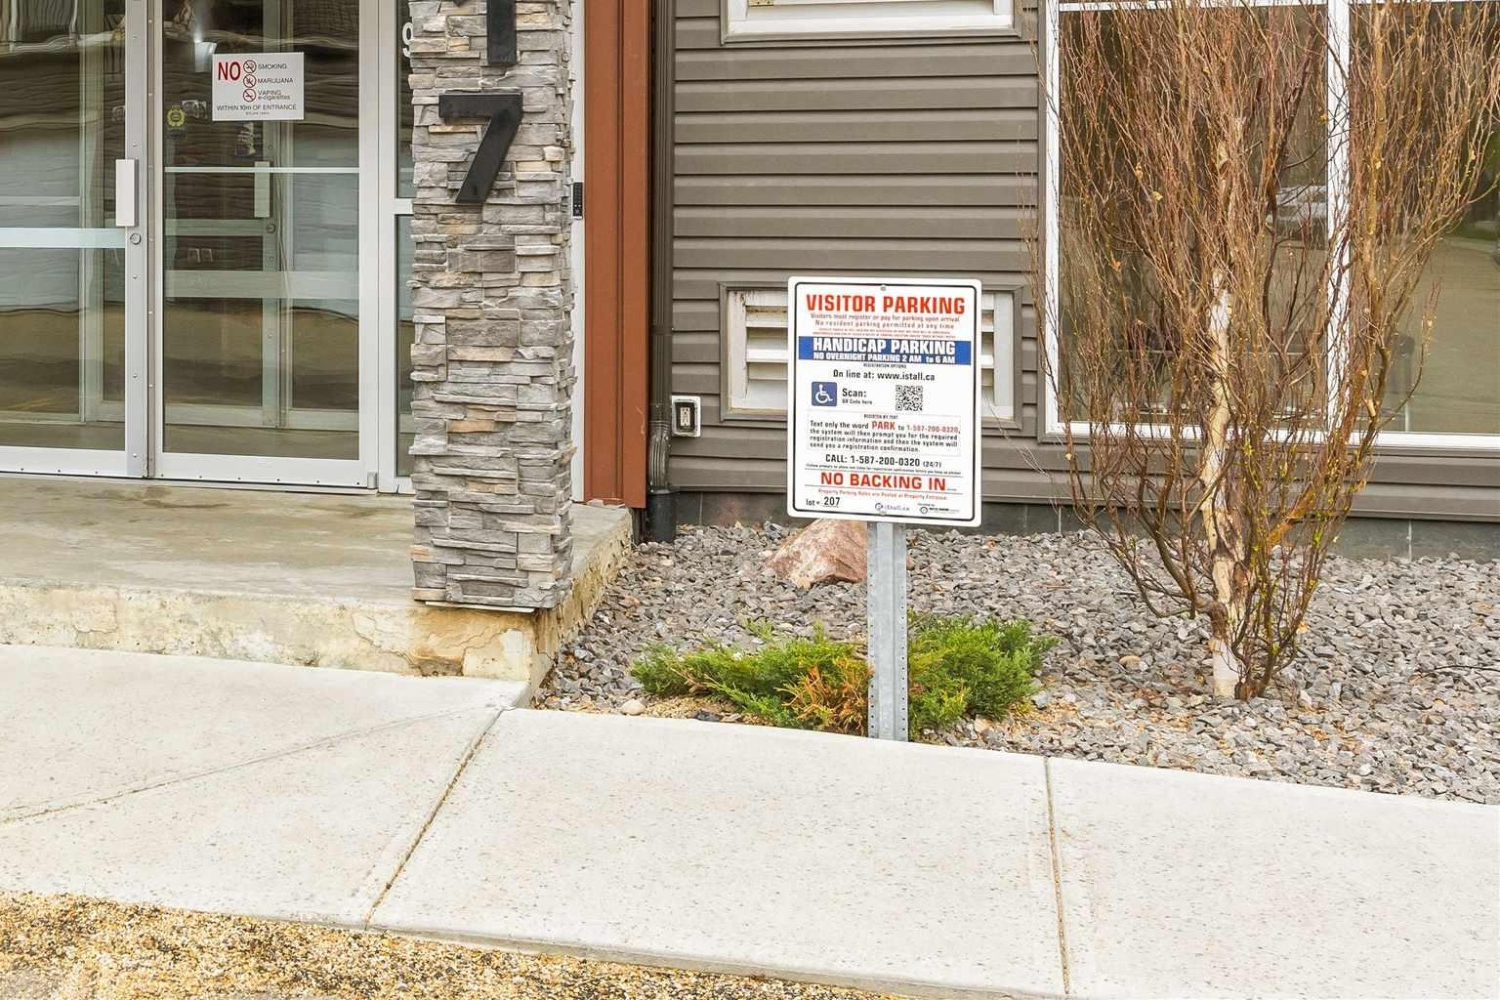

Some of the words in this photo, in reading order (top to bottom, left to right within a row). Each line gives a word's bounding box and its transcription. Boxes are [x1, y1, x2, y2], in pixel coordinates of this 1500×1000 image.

[218, 61, 241, 81] NO
[806, 294, 876, 313] VISITOR
[883, 296, 966, 315] PARKING
[813, 337, 887, 353] HANDICAP
[891, 339, 956, 355] PARKING
[813, 352, 824, 360] NO
[825, 352, 866, 361] OVERNIGHT
[867, 353, 900, 362] PARKING
[902, 354, 908, 363] 2
[909, 354, 922, 363] AM
[925, 355, 934, 363] to
[935, 355, 941, 363] 6
[942, 355, 956, 364] AM
[833, 369, 844, 377] On
[846, 370, 861, 379] line
[863, 371, 875, 379] at:
[877, 371, 935, 381] www.istall.ca
[842, 388, 867, 398] Scan:
[825, 421, 838, 429] only
[871, 420, 896, 430] PARK
[821, 429, 842, 437] system
[847, 436, 882, 444] information
[825, 453, 848, 463] CALL:
[850, 455, 920, 467] 1-587-200-0320
[922, 460, 942, 468] (24/7)
[820, 471, 844, 486] NO
[850, 473, 922, 490] BACKING
[928, 477, 947, 491] IN
[805, 498, 815, 506] lot
[823, 496, 840, 506] 207
